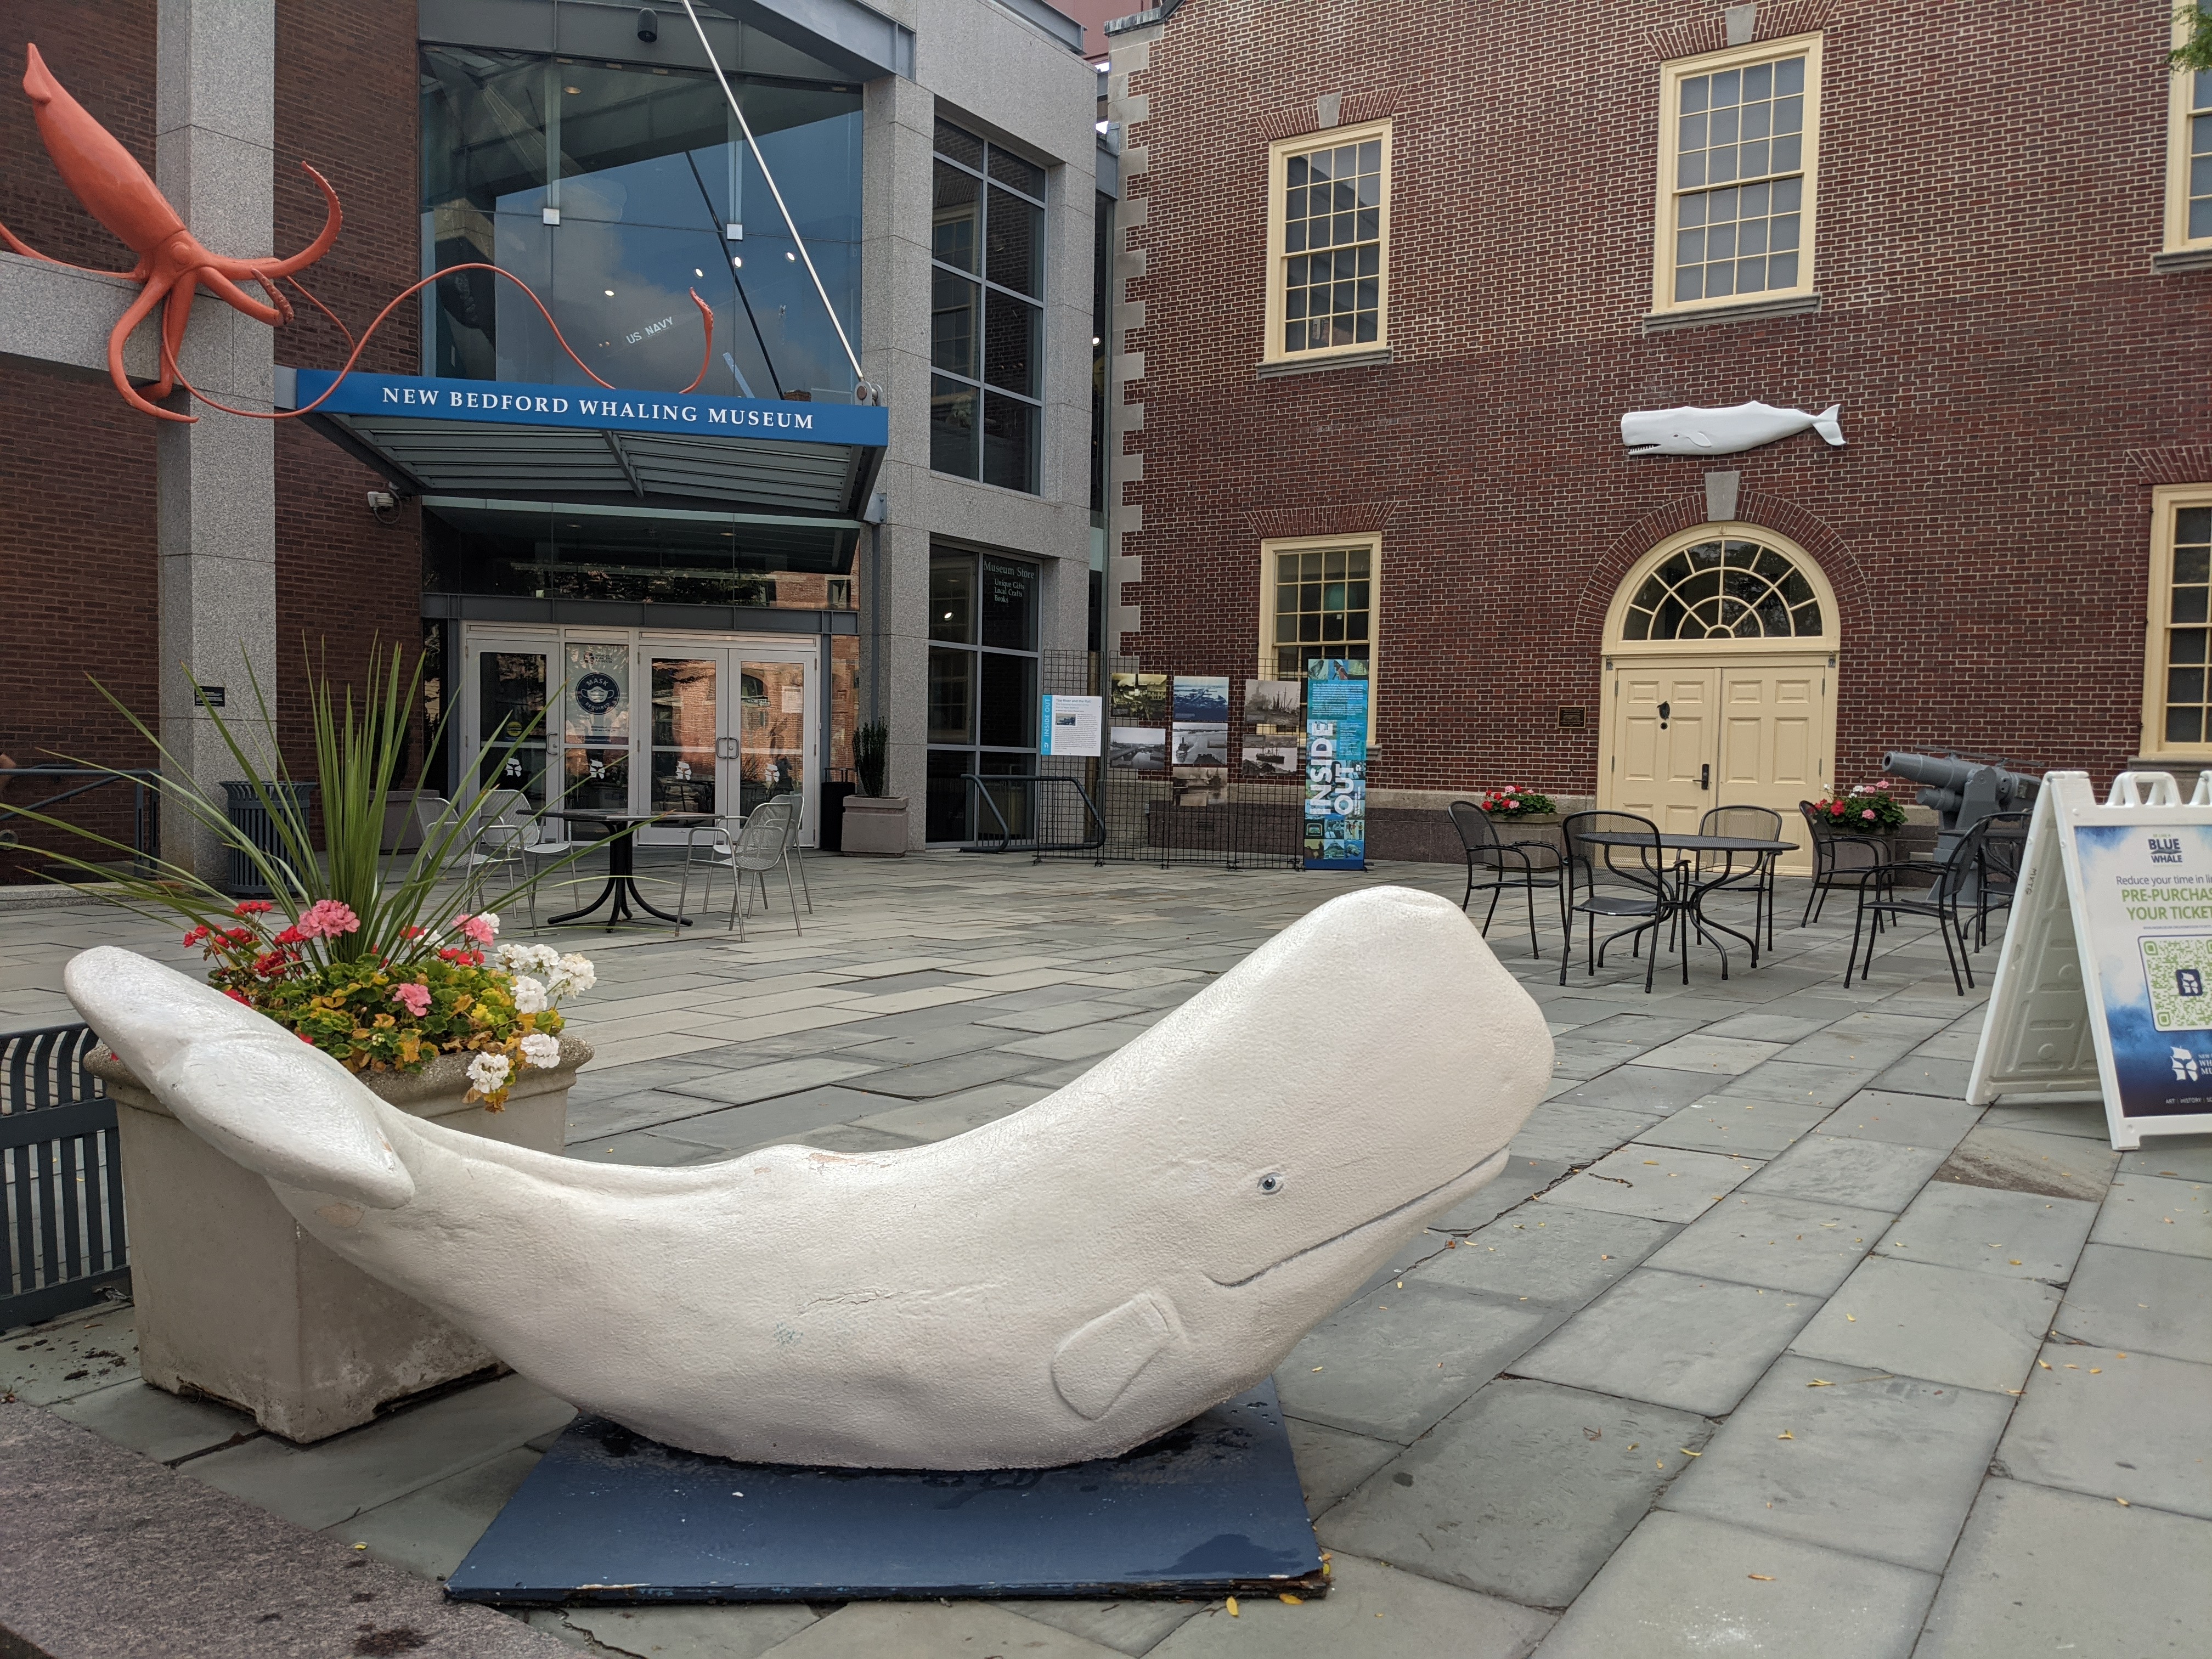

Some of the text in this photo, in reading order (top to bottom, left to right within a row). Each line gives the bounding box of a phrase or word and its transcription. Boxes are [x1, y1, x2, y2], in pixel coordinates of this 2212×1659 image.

[626, 317, 673, 344] US NAVY
[382, 387, 813, 429] NEW BEDFORD WHALING MUSEUM
[984, 561, 1034, 579] Museum Store
[995, 578, 1025, 590] Unique Gifts
[995, 594, 1008, 603] Books
[1008, 589, 1023, 597] Crafts
[586, 678, 608, 686] MASK
[585, 702, 610, 710] REQUIRED
[1310, 723, 1333, 815] INSIDE
[1334, 764, 1354, 815] OUT
[2148, 838, 2180, 850] BLUE
[2151, 855, 2183, 863] WHALE
[2116, 876, 2149, 885] Reduce
[2151, 877, 2171, 887] your
[2174, 874, 2194, 884] time
[2195, 874, 2204, 884] in
[2126, 906, 2168, 921] YOUR
